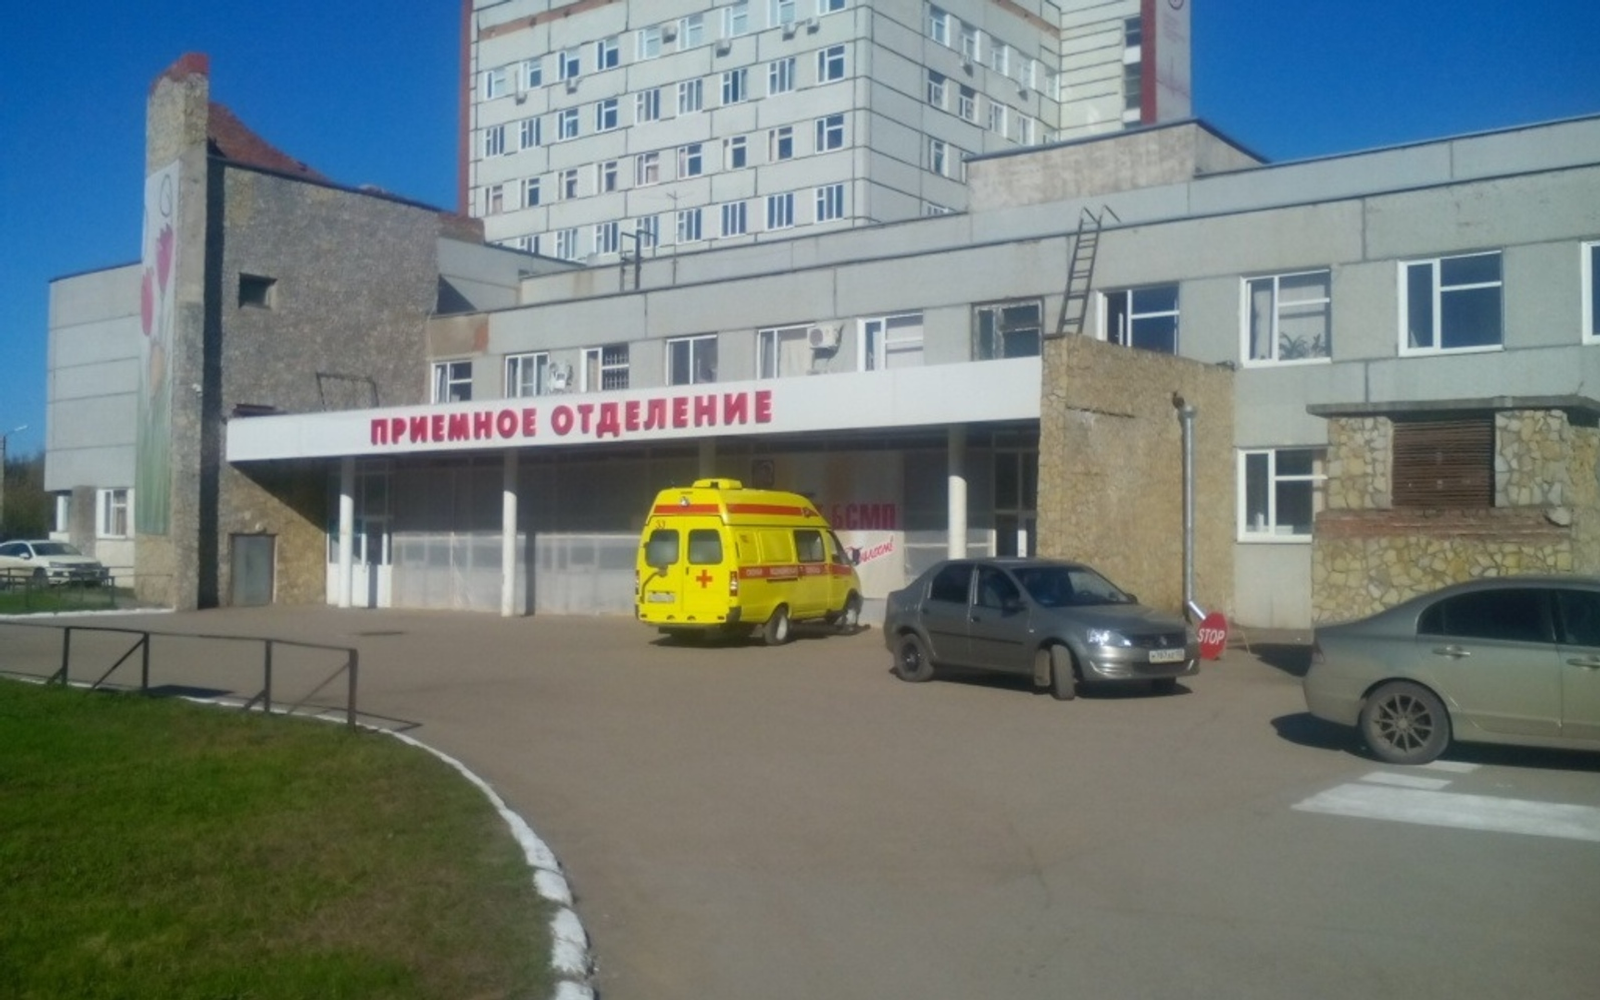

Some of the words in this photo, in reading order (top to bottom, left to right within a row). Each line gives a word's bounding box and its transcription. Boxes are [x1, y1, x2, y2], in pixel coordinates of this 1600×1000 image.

[371, 408, 537, 445] ПРИЕМНОЕ
[550, 390, 772, 438] ОТДЕЛЕНИЕ
[1197, 629, 1225, 645] STOP
